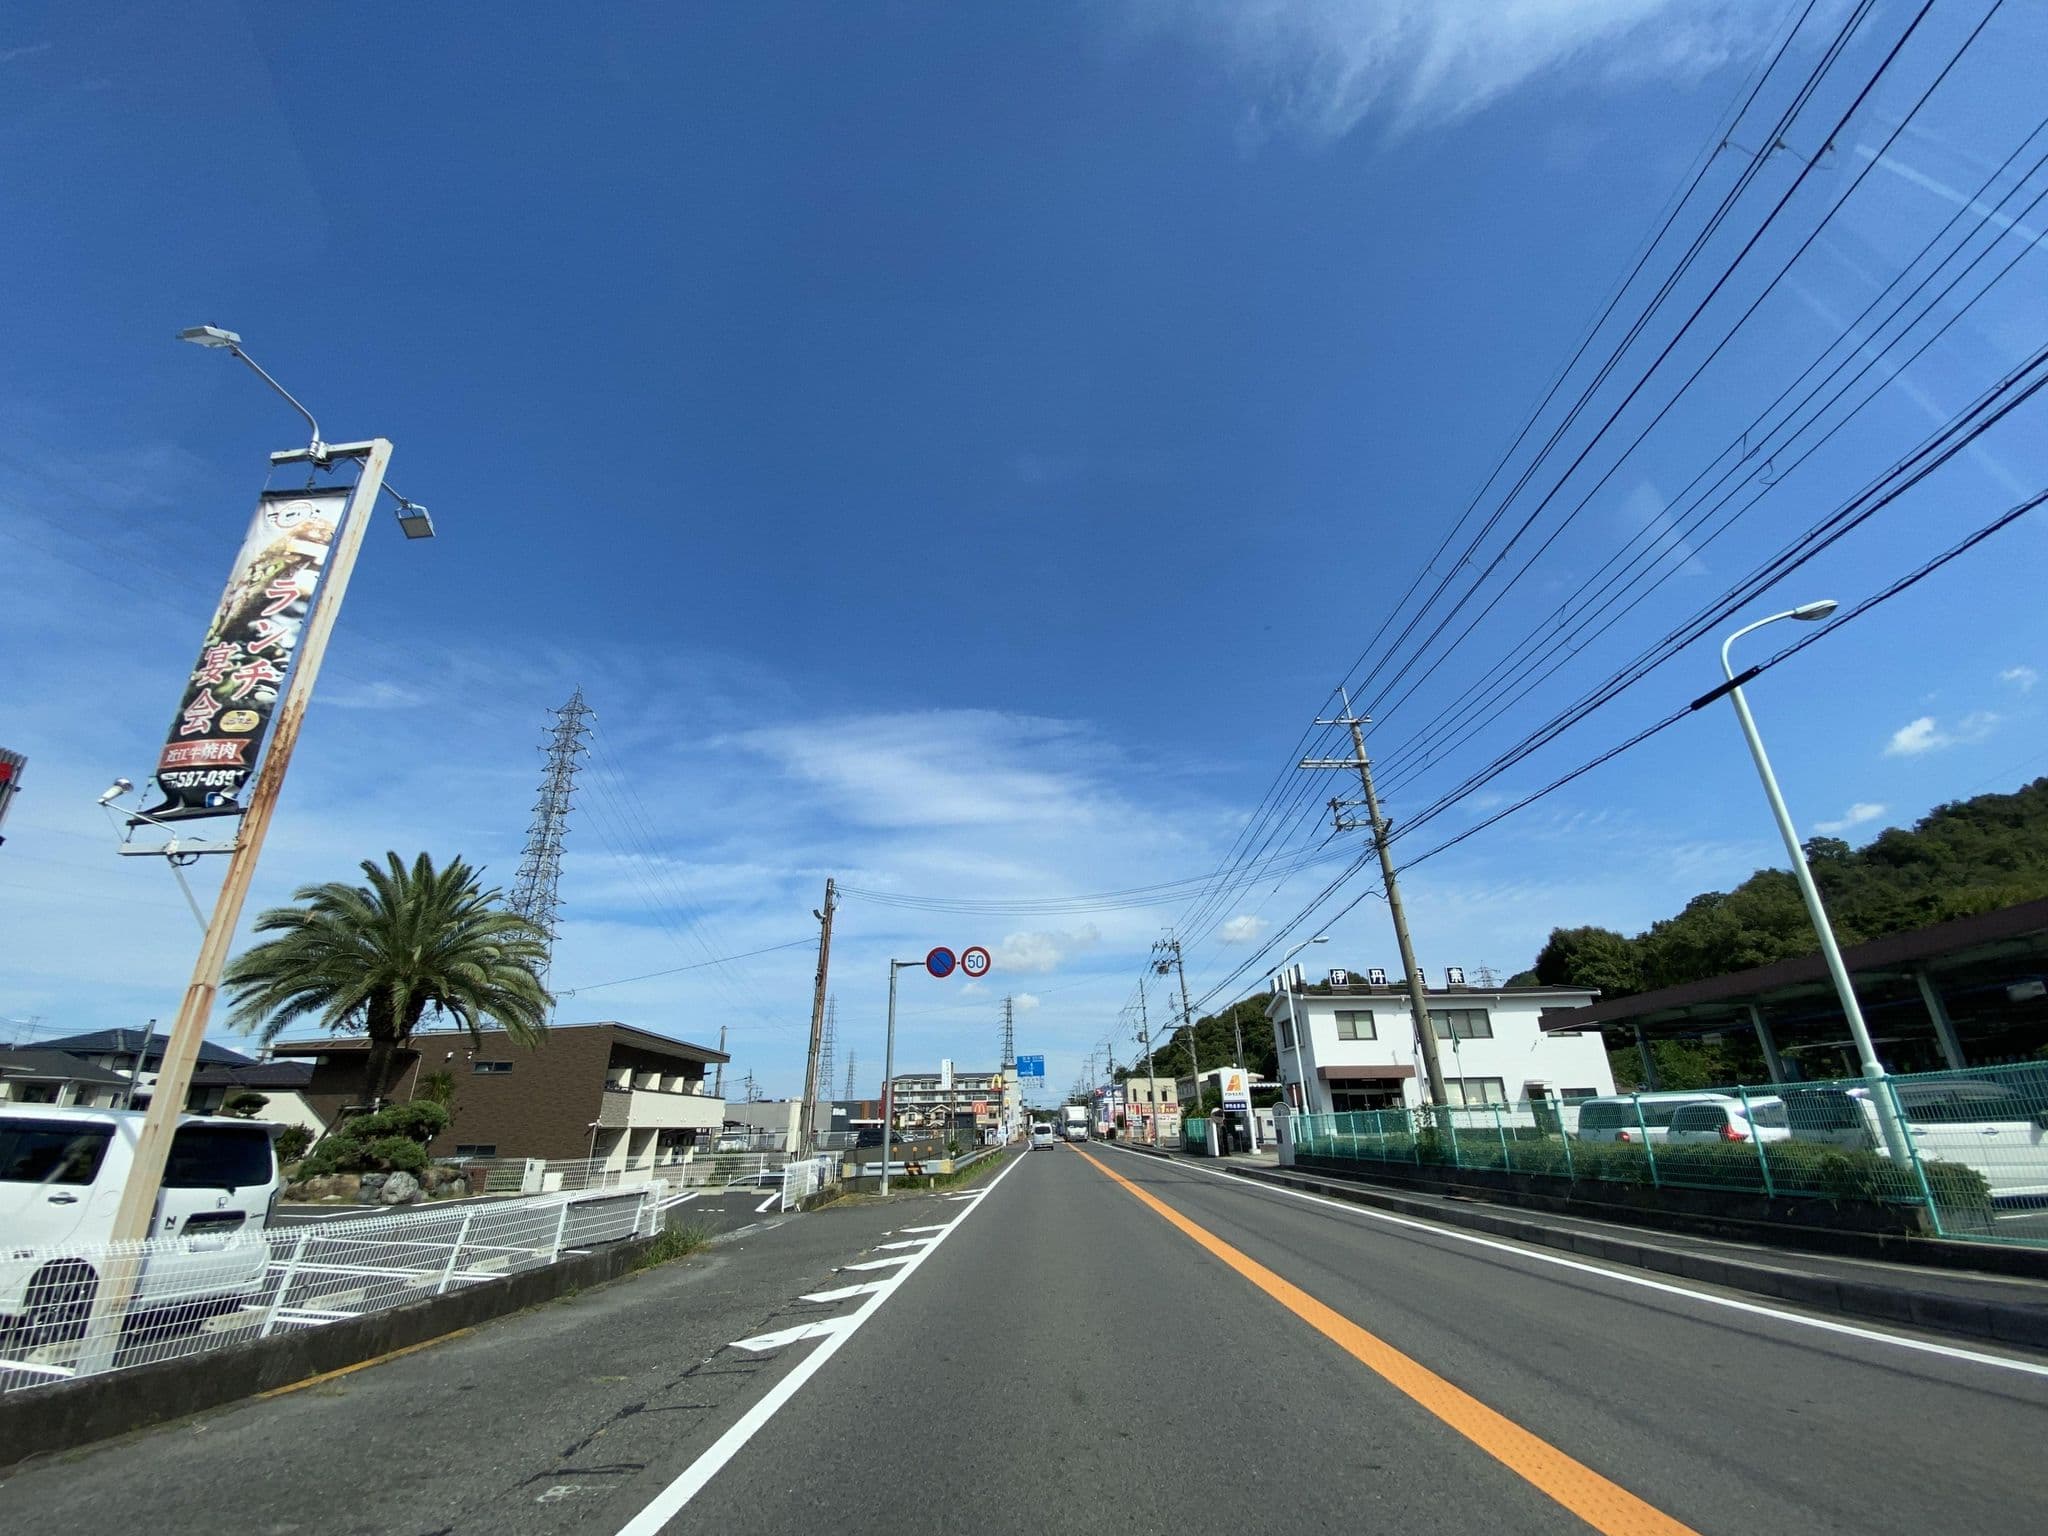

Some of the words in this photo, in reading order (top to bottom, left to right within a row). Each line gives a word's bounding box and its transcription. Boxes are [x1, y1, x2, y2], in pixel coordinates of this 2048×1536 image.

[231, 579, 300, 701] ランチ
[180, 642, 239, 737] 宴会
[165, 741, 238, 763] 近江牛焼肉
[967, 954, 985, 969] 50
